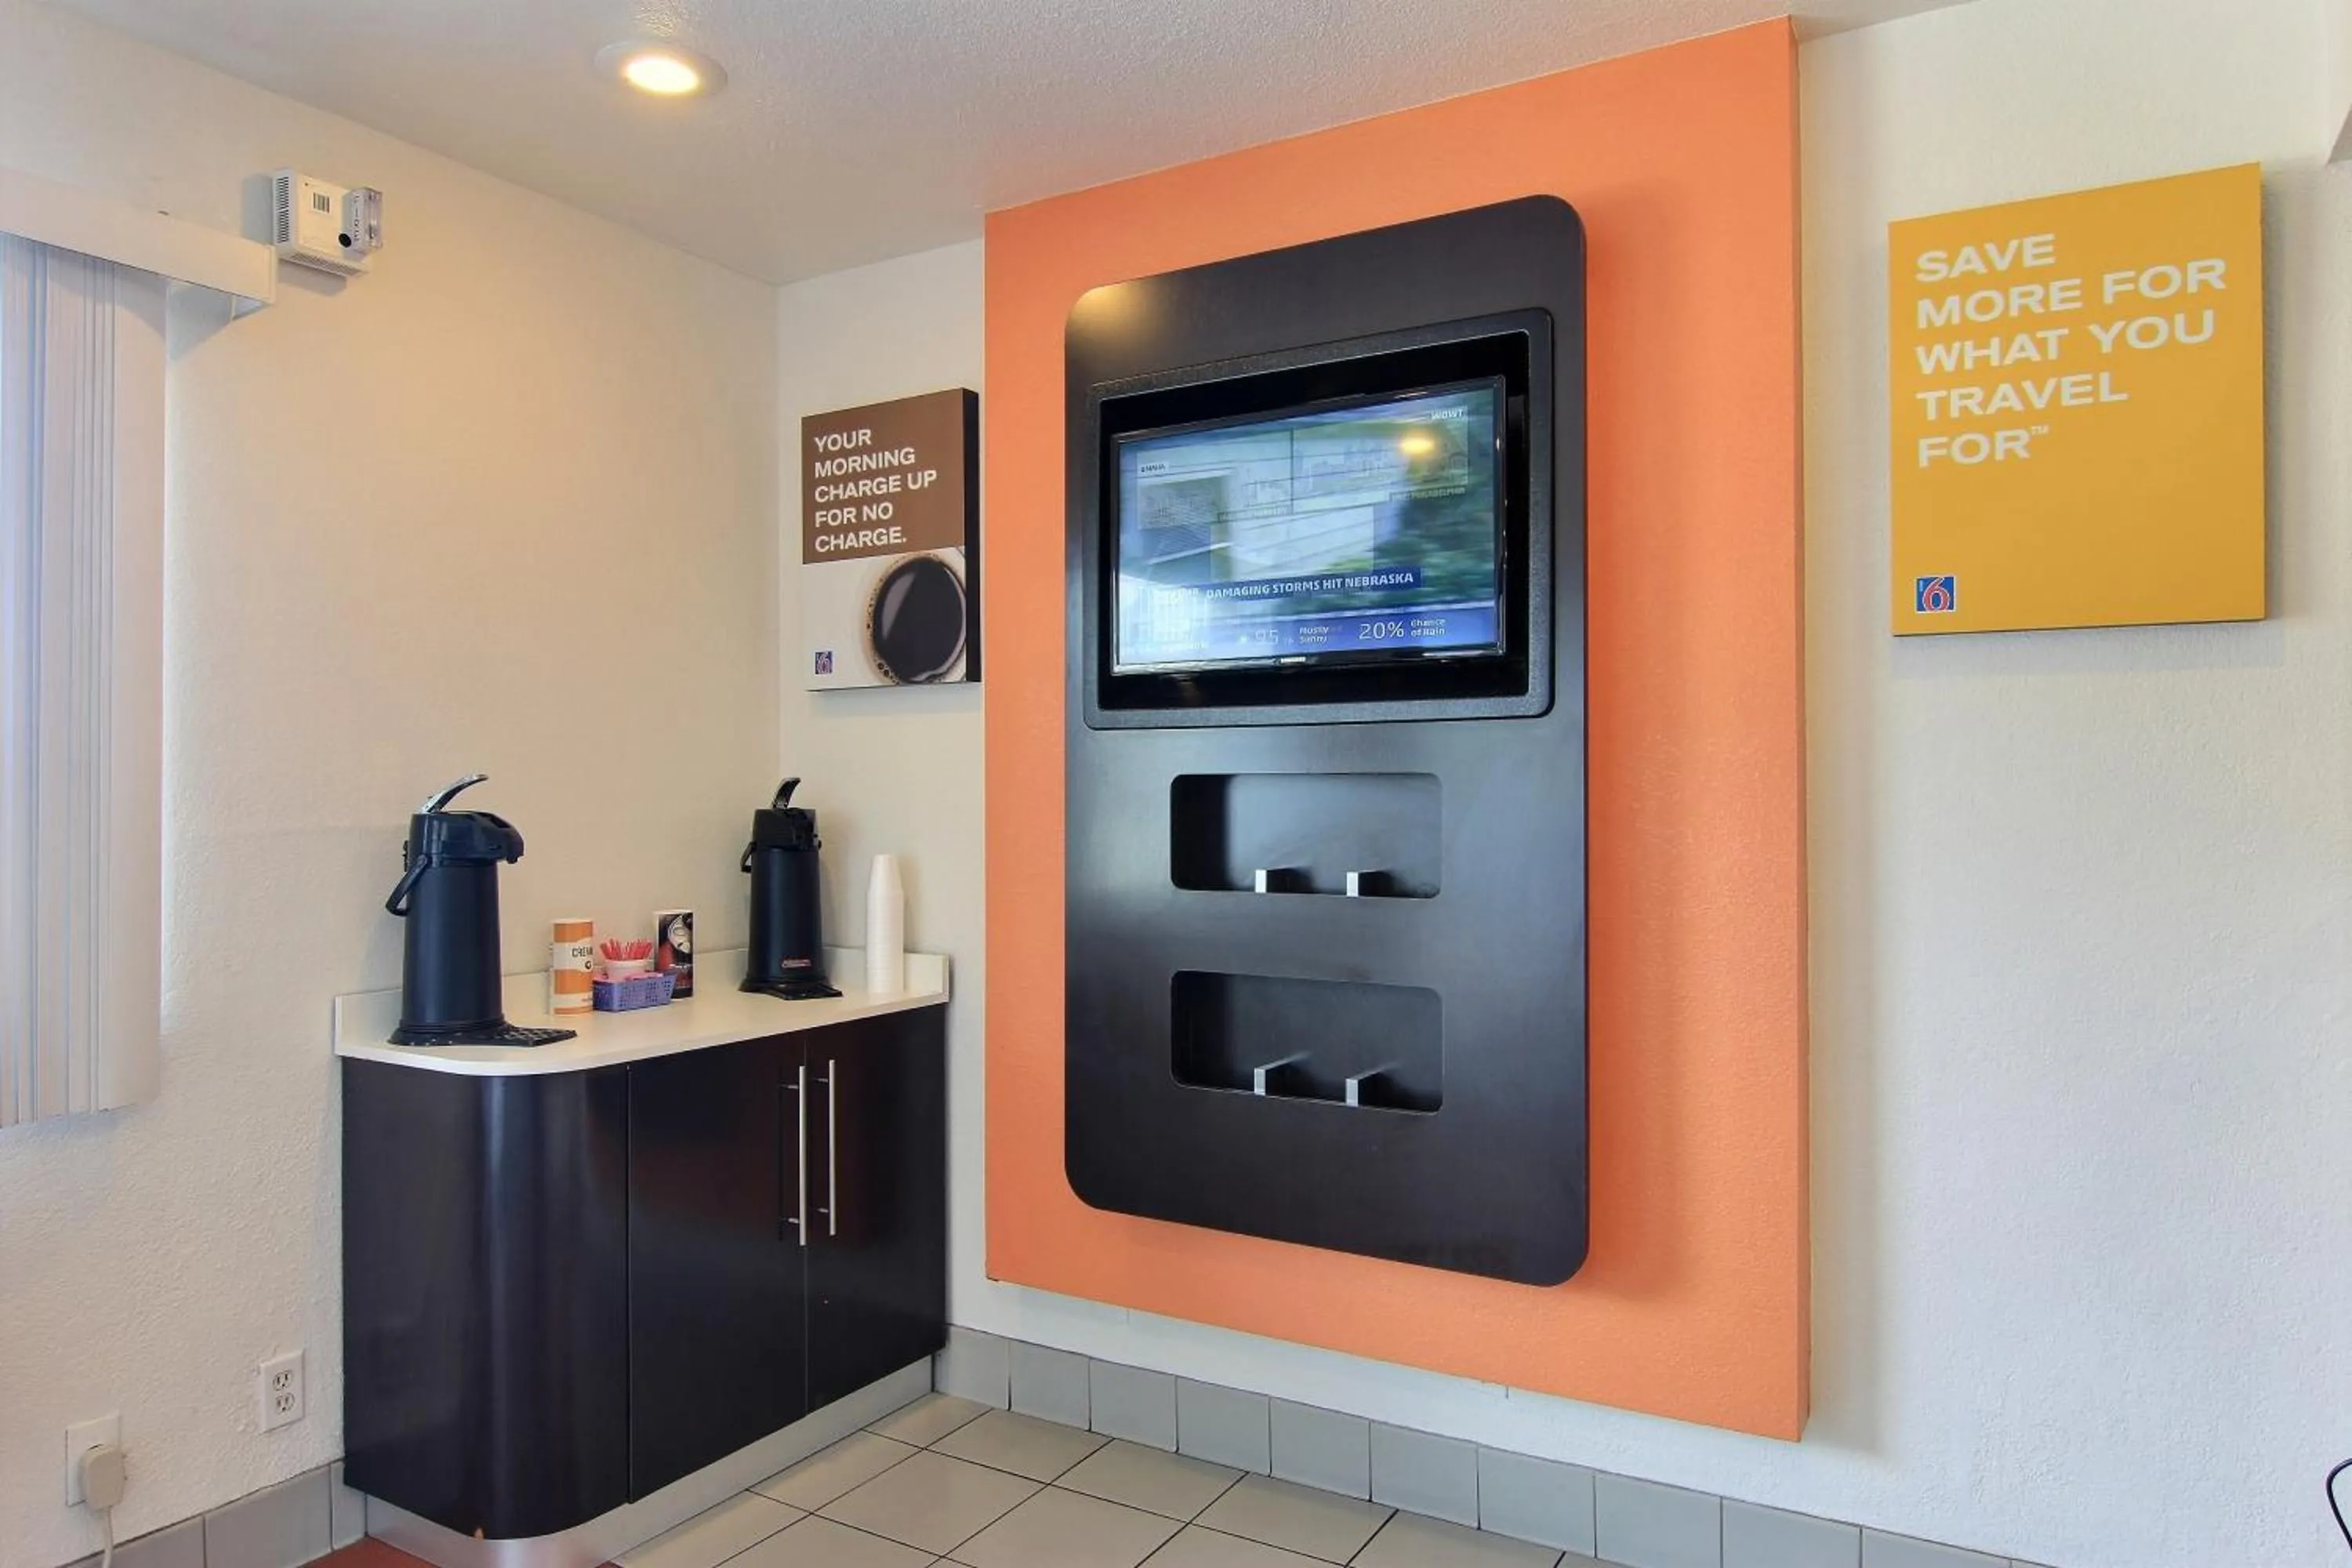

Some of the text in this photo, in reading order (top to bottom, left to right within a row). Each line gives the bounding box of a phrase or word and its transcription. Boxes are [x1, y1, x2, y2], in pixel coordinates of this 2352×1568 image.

[1916, 234, 2056, 282] SAVE
[1918, 259, 2227, 328] MORE FOR
[1915, 310, 2215, 375] WHAT YOU
[1915, 371, 2129, 420] TRAVEL
[814, 429, 872, 453] YOUR
[814, 448, 916, 478] MORNING
[814, 470, 938, 503] CHARGE UP
[815, 502, 893, 528] FOR NO
[815, 527, 907, 553] CHARGE.
[1207, 584, 1269, 599] DAMAGING
[1272, 579, 1319, 593] STORMS
[1323, 578, 1343, 590] HIT
[1345, 572, 1414, 588] NEBRASKA
[1359, 622, 1405, 640] 20%
